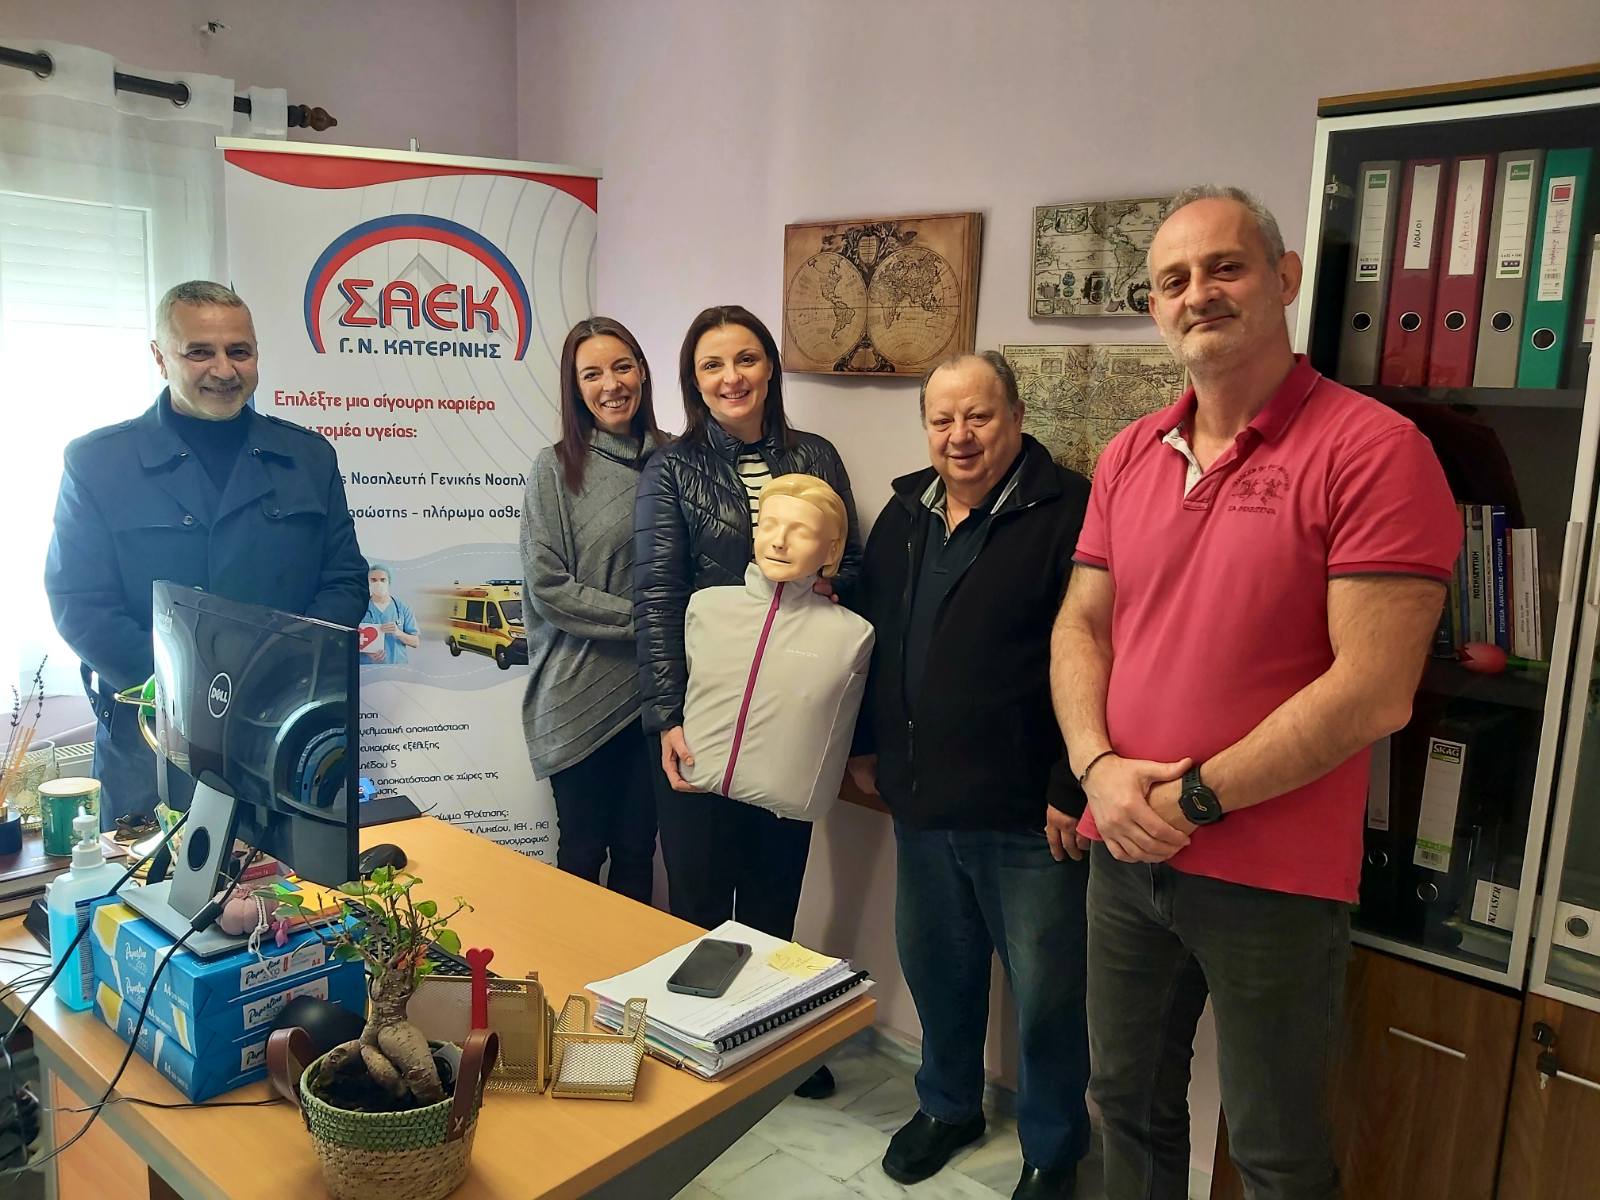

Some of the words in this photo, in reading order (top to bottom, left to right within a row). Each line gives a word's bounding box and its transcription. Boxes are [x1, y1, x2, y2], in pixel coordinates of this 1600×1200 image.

[337, 279, 500, 333] ΣΑΕΚ
[340, 338, 353, 353] Γ.
[358, 338, 378, 354] Ν.
[384, 339, 502, 358] ΚΑΤΕΡΙΝΗΣ
[274, 390, 342, 411] Επιλέξτε
[346, 396, 369, 411] μια
[373, 393, 434, 413] σίγουρη
[438, 395, 496, 414] καριέρα
[316, 422, 361, 440] τομέα
[365, 423, 417, 441] υγείας:
[351, 472, 426, 485] Νοσηλευτή
[431, 472, 480, 486] Γενικής
[485, 472, 528, 486] Νοσηλ
[348, 505, 407, 518] ασώστης
[423, 505, 484, 521] πλήρωμα
[489, 505, 520, 518] ασθε
[211, 687, 228, 703] DELL
[360, 726, 403, 737] γελματική
[406, 723, 470, 734] αποκατάσταση
[391, 760, 397, 768] 5
[377, 775, 442, 786] αποκατάσταση
[464, 810, 509, 819] Φοίτησης:
